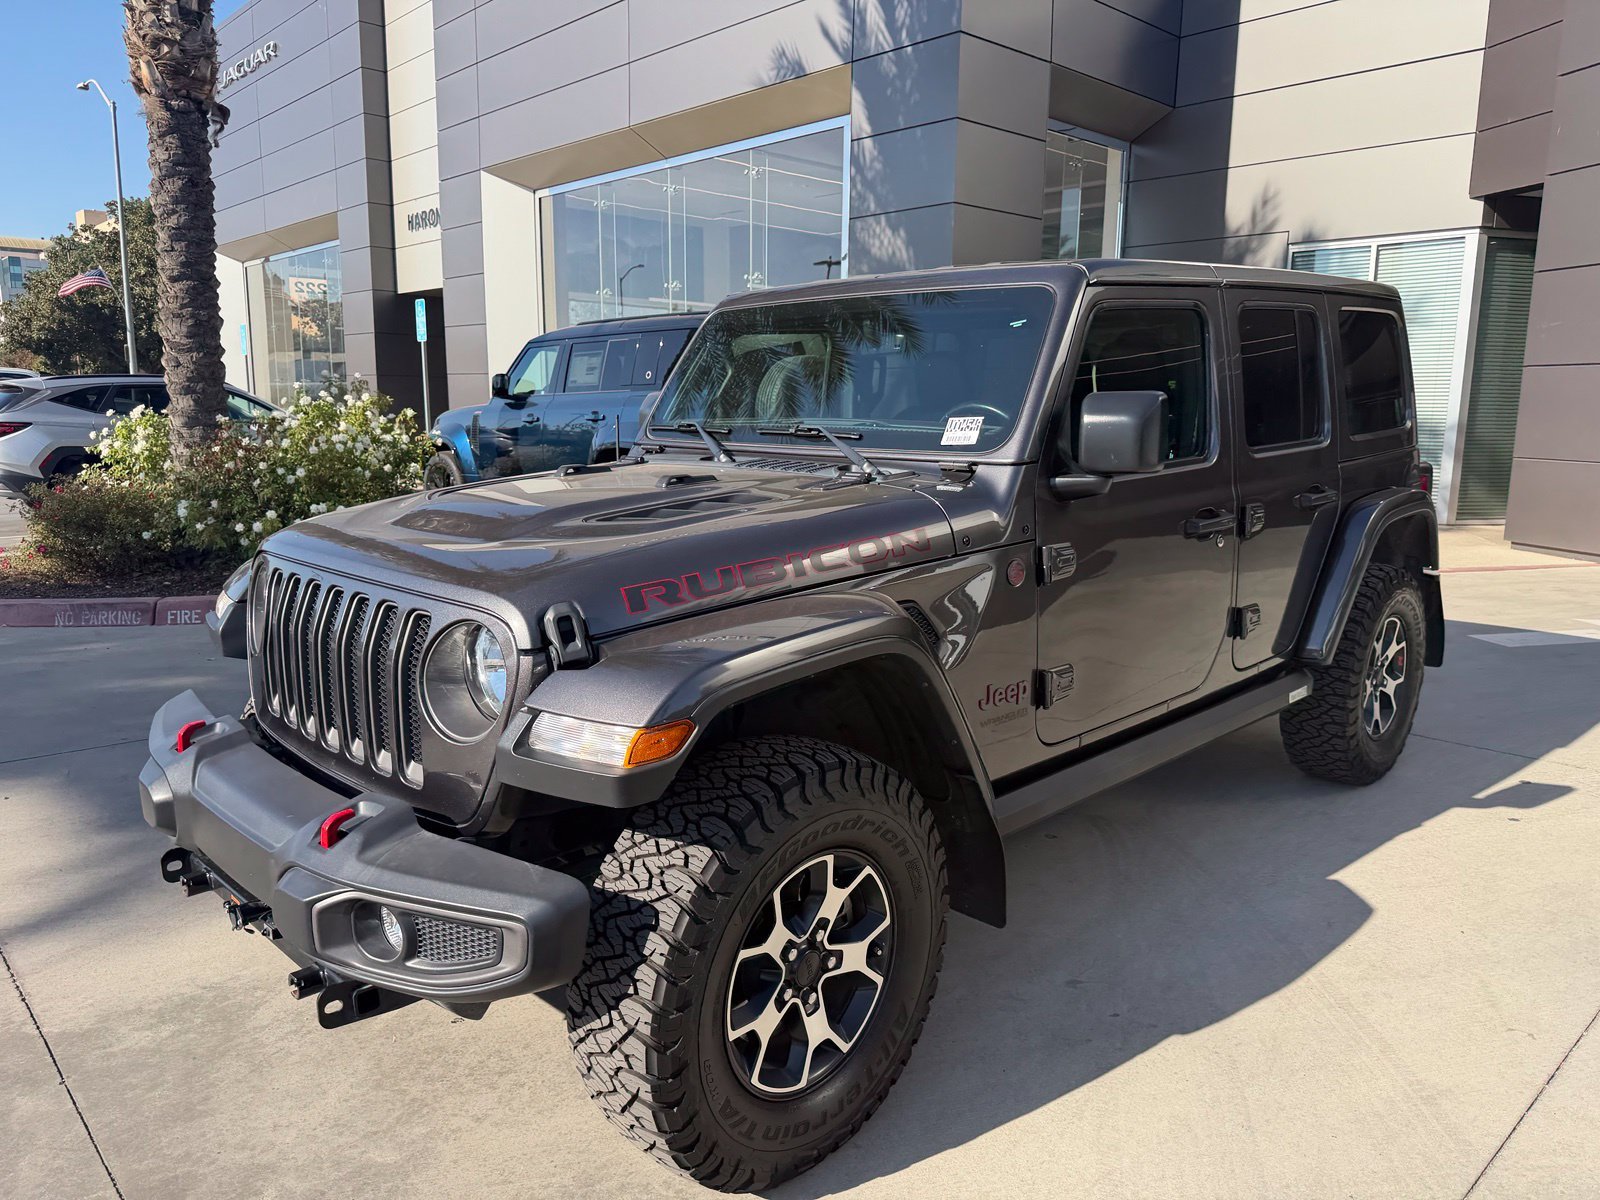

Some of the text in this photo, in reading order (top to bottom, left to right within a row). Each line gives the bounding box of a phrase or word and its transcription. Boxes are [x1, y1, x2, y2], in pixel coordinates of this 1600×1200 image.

[218, 41, 278, 90] JAGUAR
[619, 528, 932, 615] RUBICON
[54, 610, 142, 626] NO PARKING
[167, 609, 202, 624] FIRE
[977, 679, 1029, 711] Jeep
[739, 814, 911, 921] BFGoodrich
